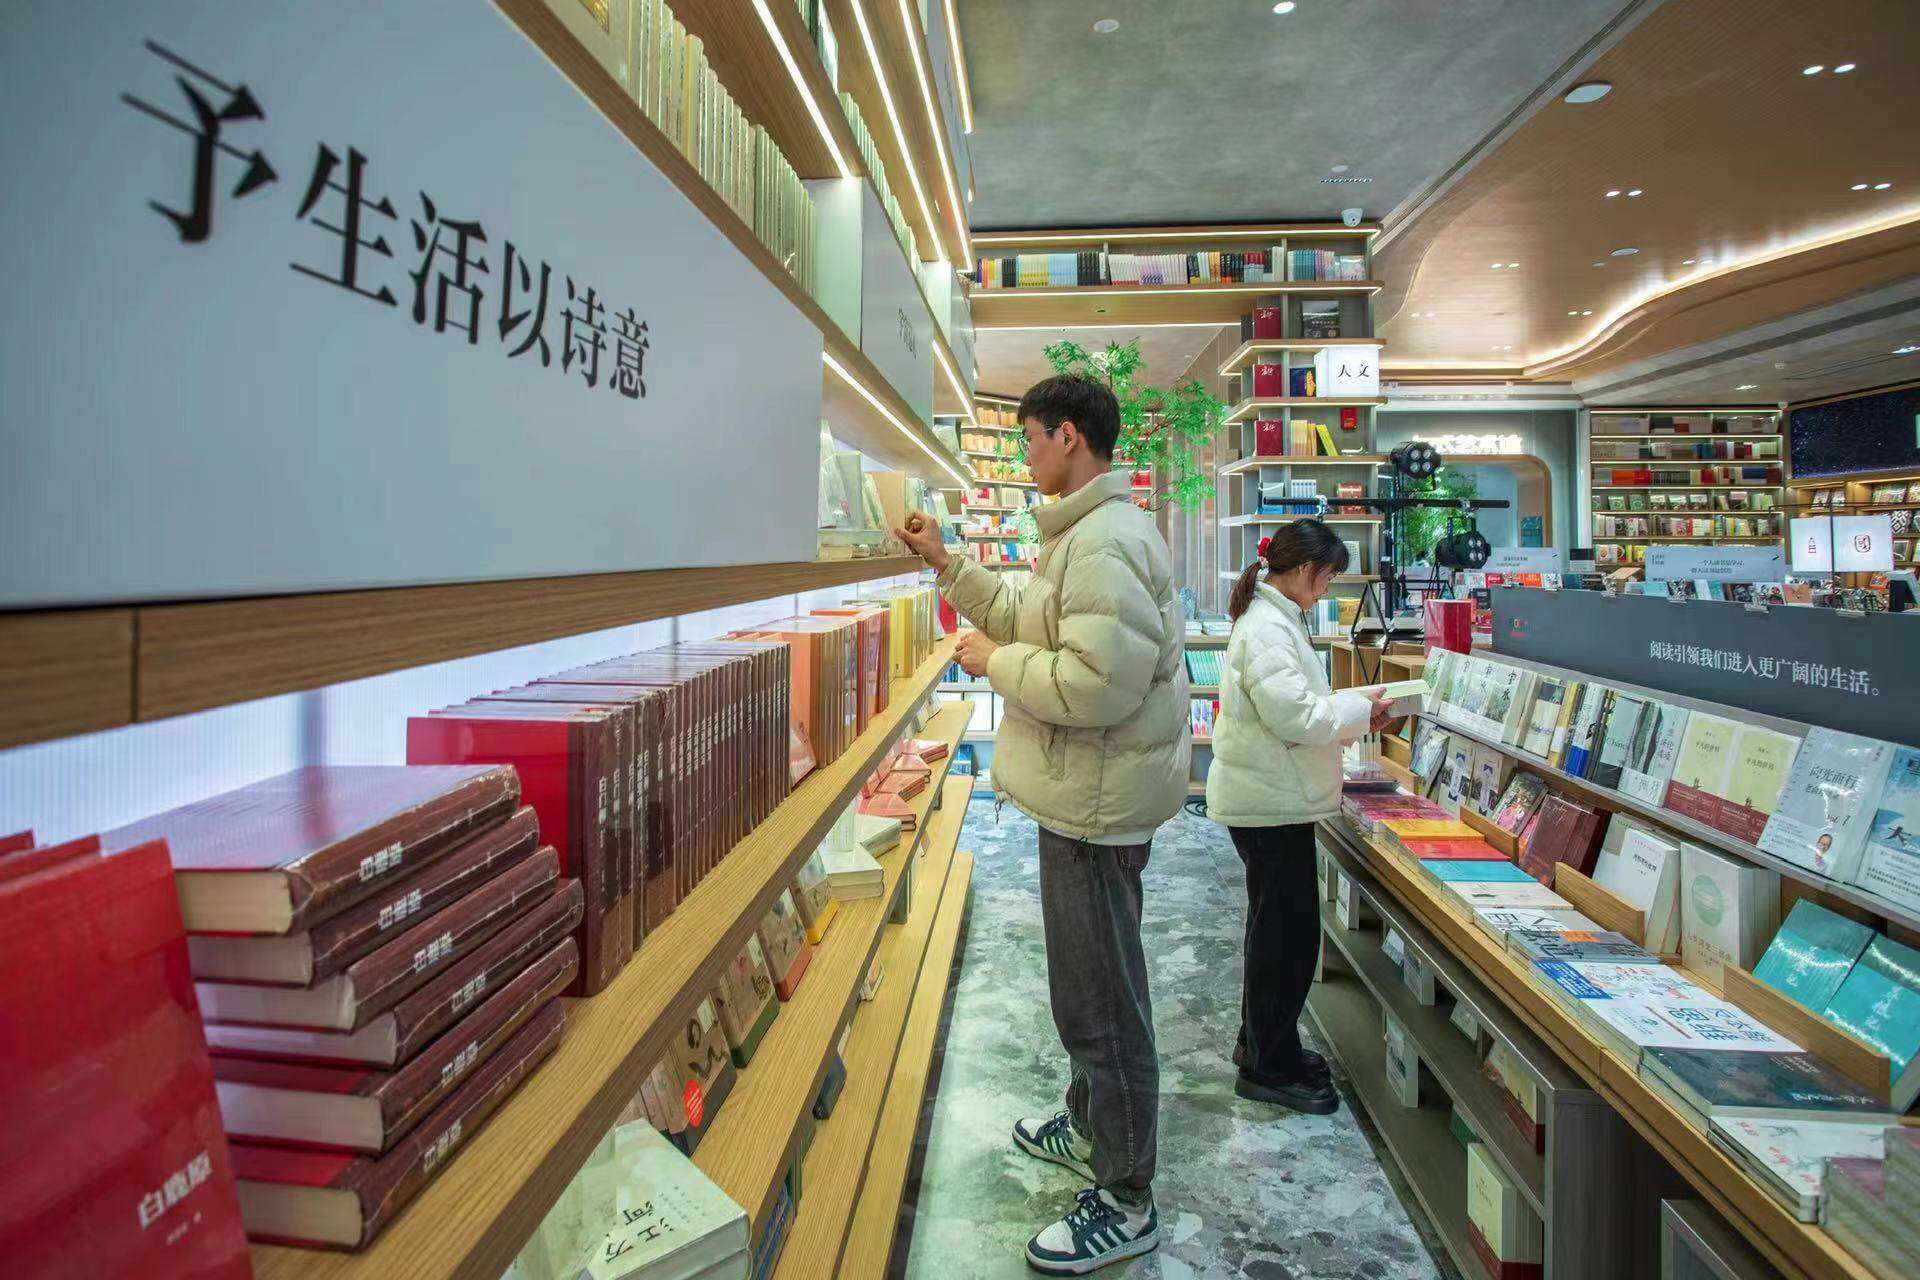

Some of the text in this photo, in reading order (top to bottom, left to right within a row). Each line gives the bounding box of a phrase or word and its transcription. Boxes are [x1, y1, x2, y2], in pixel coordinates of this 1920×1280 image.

[119, 38, 652, 400] 予生活以诗意
[1650, 639, 1880, 697] 阅读引领我们进入更广阔的生活。
